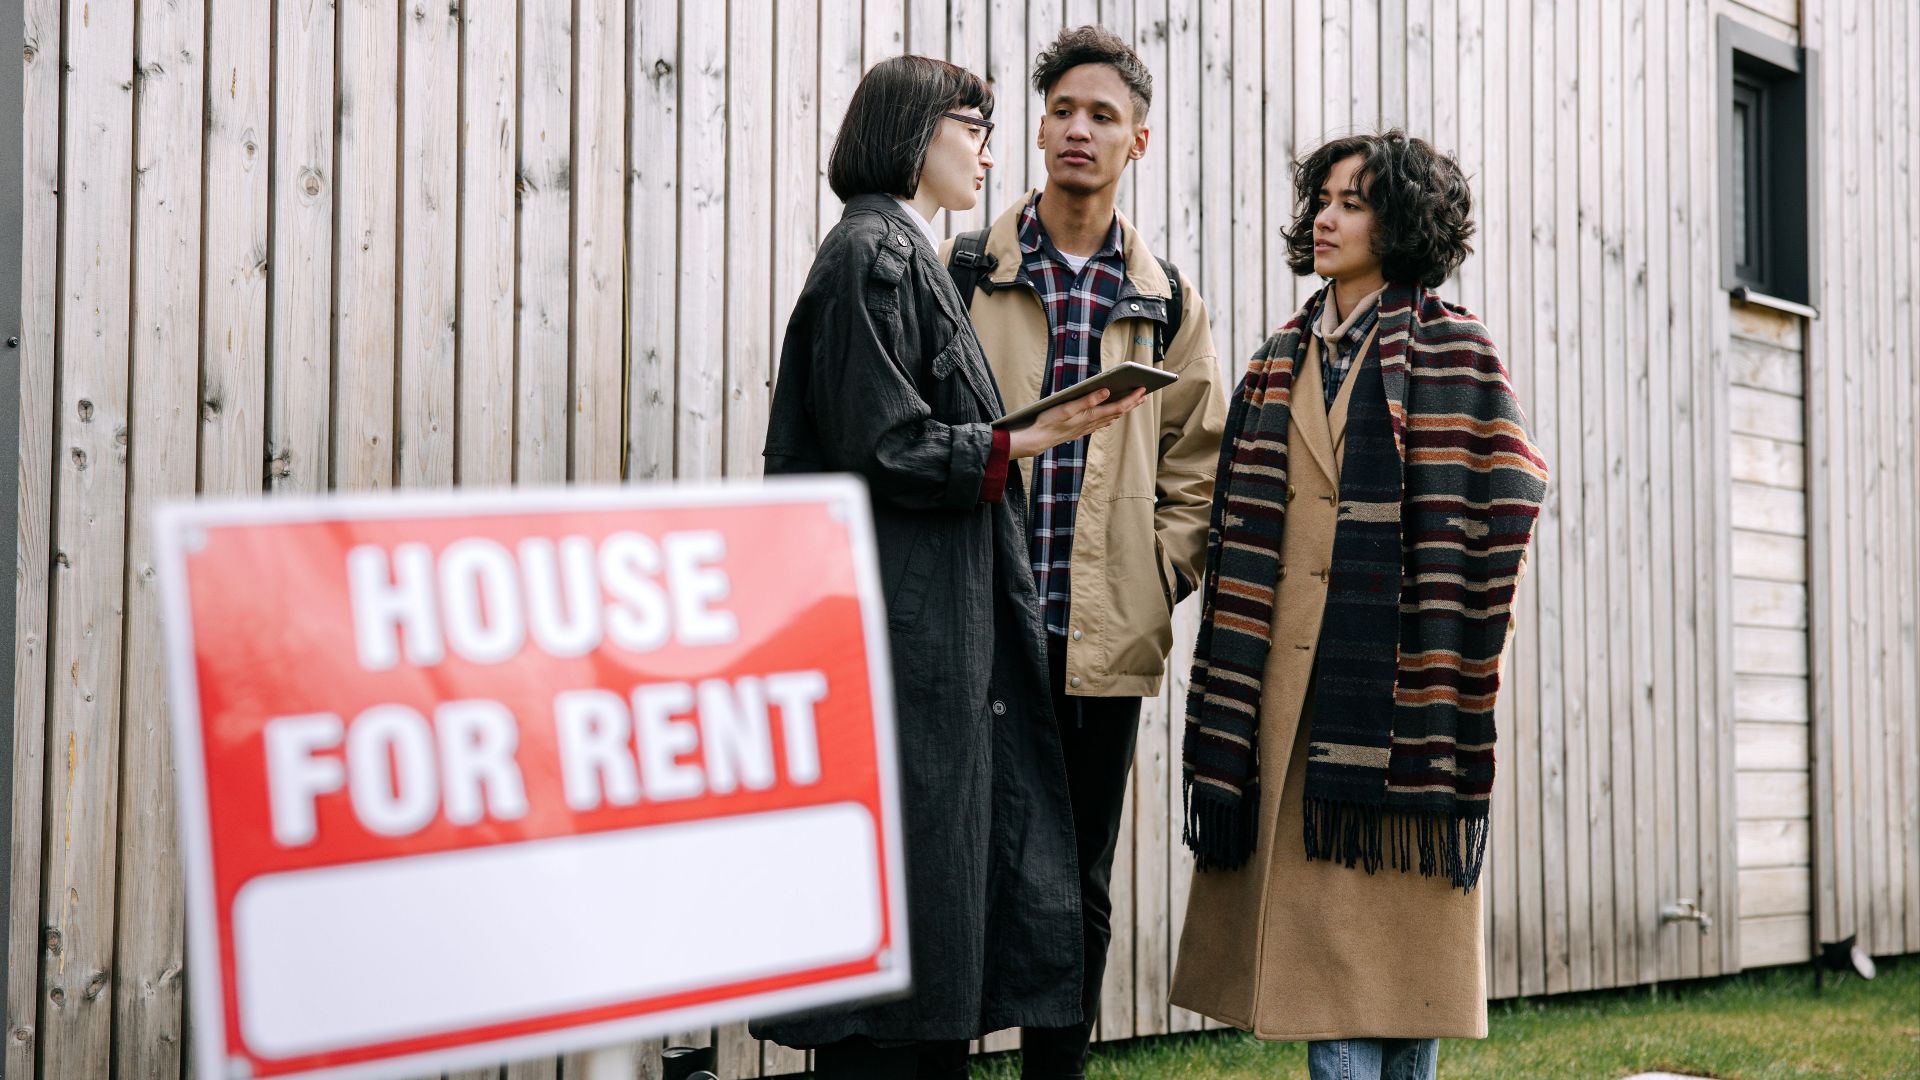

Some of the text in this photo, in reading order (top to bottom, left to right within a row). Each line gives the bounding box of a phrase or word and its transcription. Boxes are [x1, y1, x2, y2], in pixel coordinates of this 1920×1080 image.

[347, 530, 739, 671] HOUSE
[263, 670, 828, 847] FOR RENT
